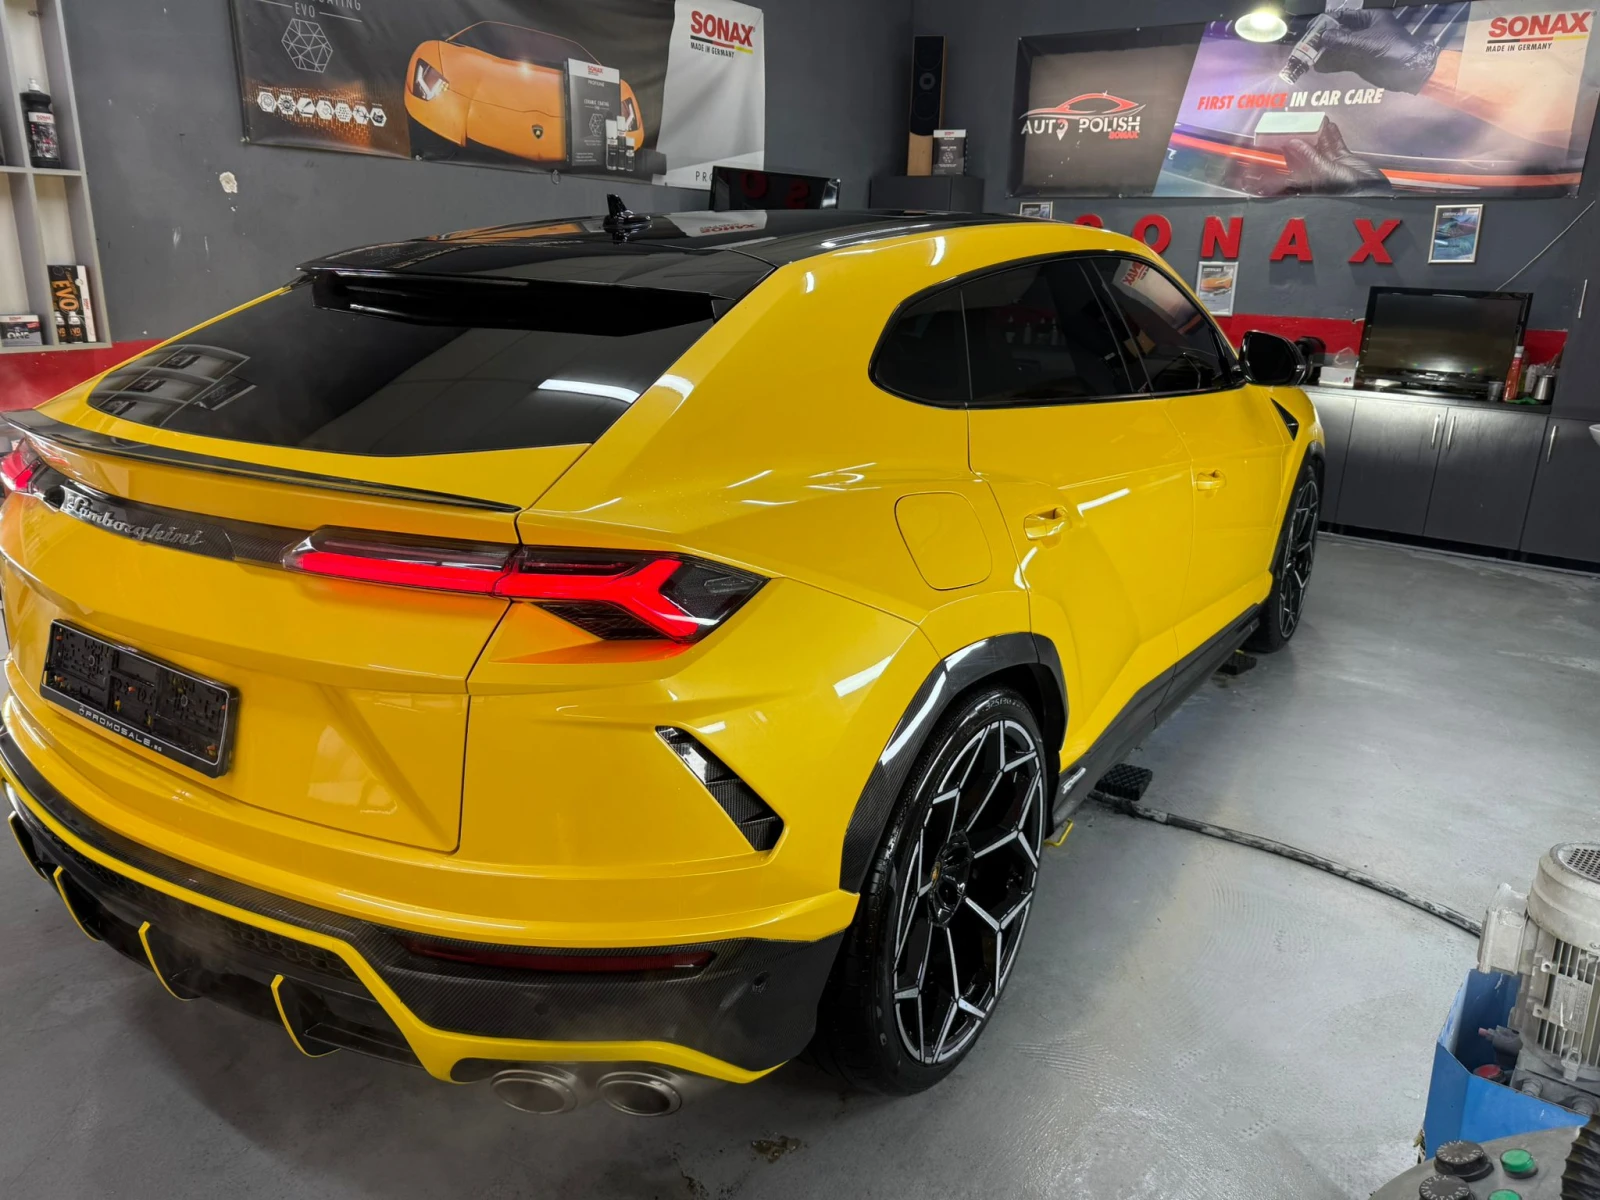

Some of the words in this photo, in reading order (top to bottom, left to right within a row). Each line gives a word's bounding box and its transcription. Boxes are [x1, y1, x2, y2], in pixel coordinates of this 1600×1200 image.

[294, 2, 315, 18] EVO
[690, 10, 754, 47] SONAX
[1488, 11, 1592, 38] SONAX
[690, 42, 704, 52] MADE
[705, 45, 711, 53] IN
[711, 46, 735, 59] GERMANY
[1485, 45, 1505, 53] MADE
[1507, 44, 1516, 52] IN
[1517, 42, 1553, 52] GERMANY
[1197, 95, 1235, 110] FIRST
[1236, 92, 1288, 109] CHOICE
[1289, 91, 1309, 108] IN
[1310, 89, 1342, 107] CAR
[1344, 87, 1386, 105] CARE
[1078, 116, 1141, 134] POLISH
[51, 280, 80, 312] EVO
[66, 496, 206, 545] Lamborghini
